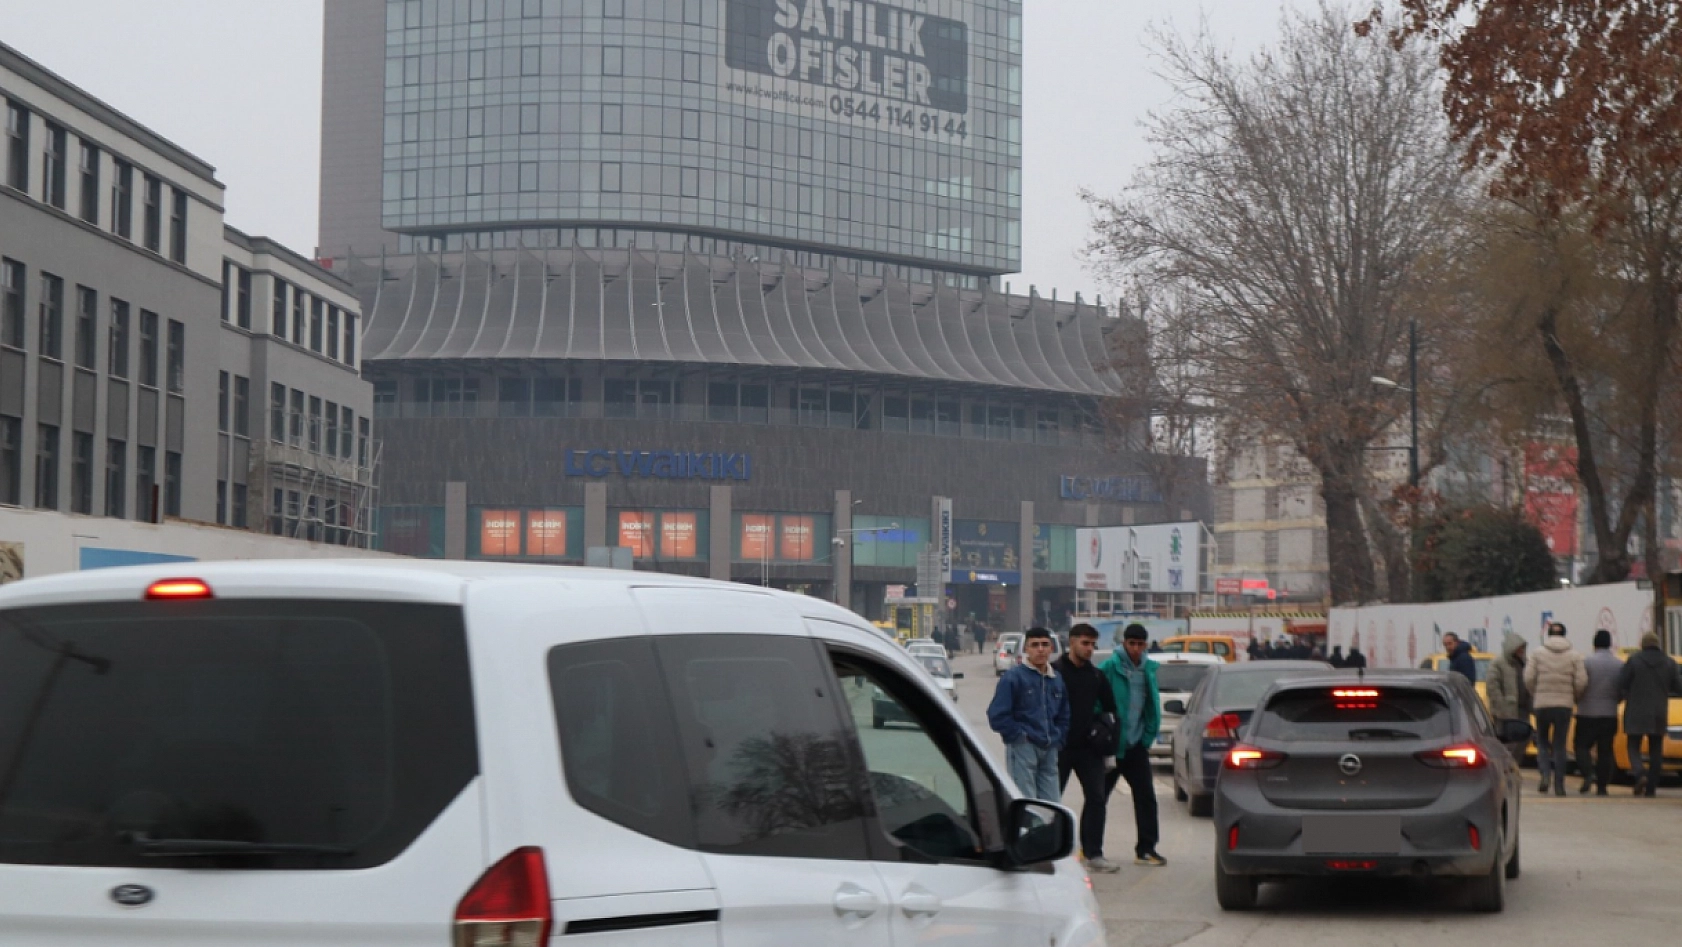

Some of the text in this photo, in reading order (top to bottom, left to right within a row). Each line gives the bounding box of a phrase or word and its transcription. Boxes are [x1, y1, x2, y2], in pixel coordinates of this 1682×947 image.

[774, 0, 925, 58] SATILIK
[829, 94, 968, 139] 0544 114 91 44
[565, 448, 611, 477] LC
